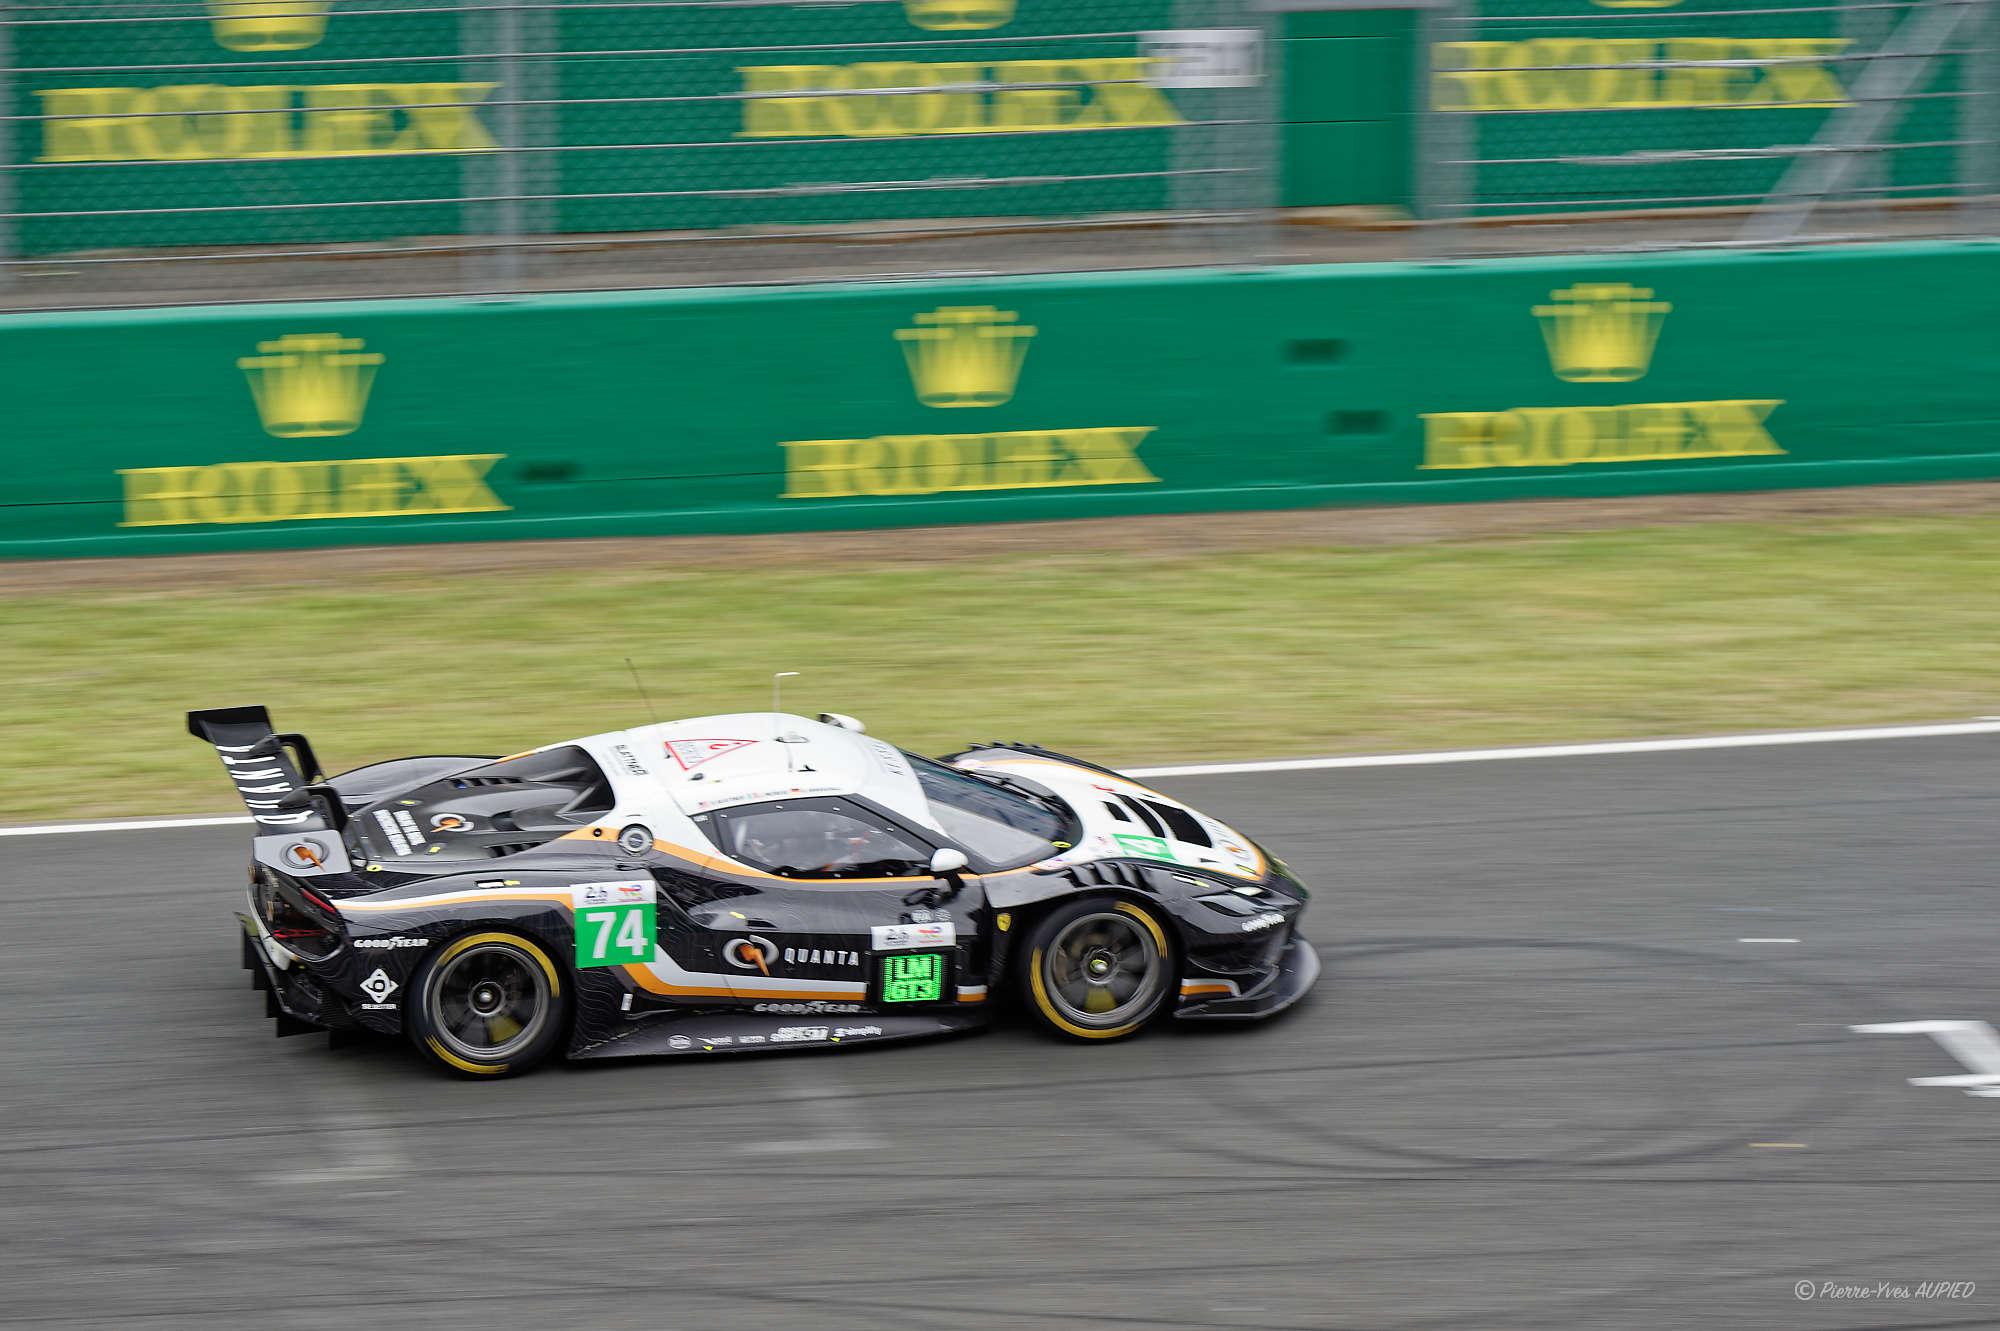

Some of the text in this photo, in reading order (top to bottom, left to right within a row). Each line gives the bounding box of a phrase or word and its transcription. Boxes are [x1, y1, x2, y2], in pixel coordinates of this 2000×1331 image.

[735, 56, 1186, 137] ROLEX
[1434, 37, 1856, 110] ROLEX
[34, 82, 500, 162] ROLEX
[777, 425, 1162, 499] ROLEX
[1417, 399, 1787, 469] ROLEX
[115, 453, 513, 527] ROLEX
[353, 936, 430, 950] GOODYEAR
[585, 909, 649, 959] 74
[783, 947, 860, 966] QUANTA
[895, 958, 932, 979] LM
[753, 1000, 862, 1015] GOODYEAR
